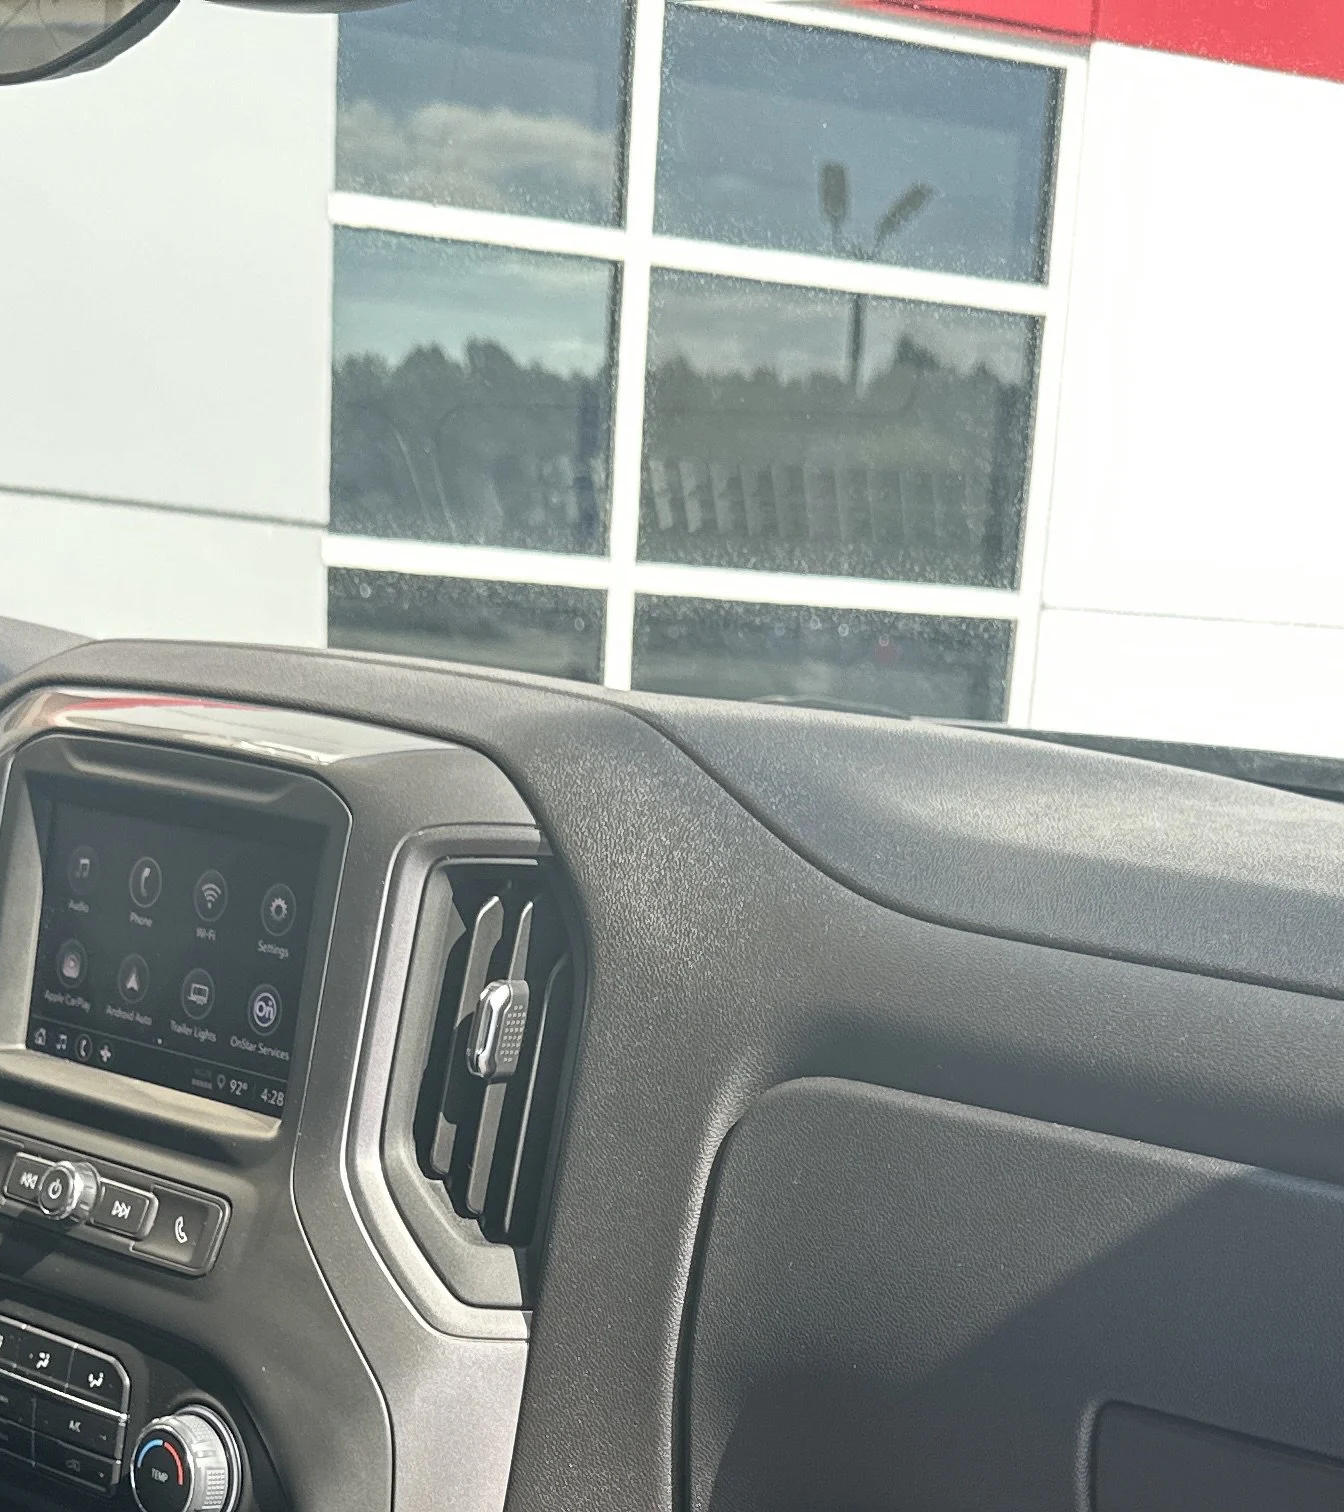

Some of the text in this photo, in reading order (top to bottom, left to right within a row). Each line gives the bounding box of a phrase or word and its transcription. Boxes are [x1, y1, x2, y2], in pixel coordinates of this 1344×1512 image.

[129, 911, 153, 928] Phone
[196, 927, 217, 942] Wi-Fi
[257, 940, 289, 960] Settings
[170, 1019, 217, 1043] Trailer Lights
[230, 1035, 290, 1061] OnStar Services
[151, 1467, 169, 1483] TEMP
